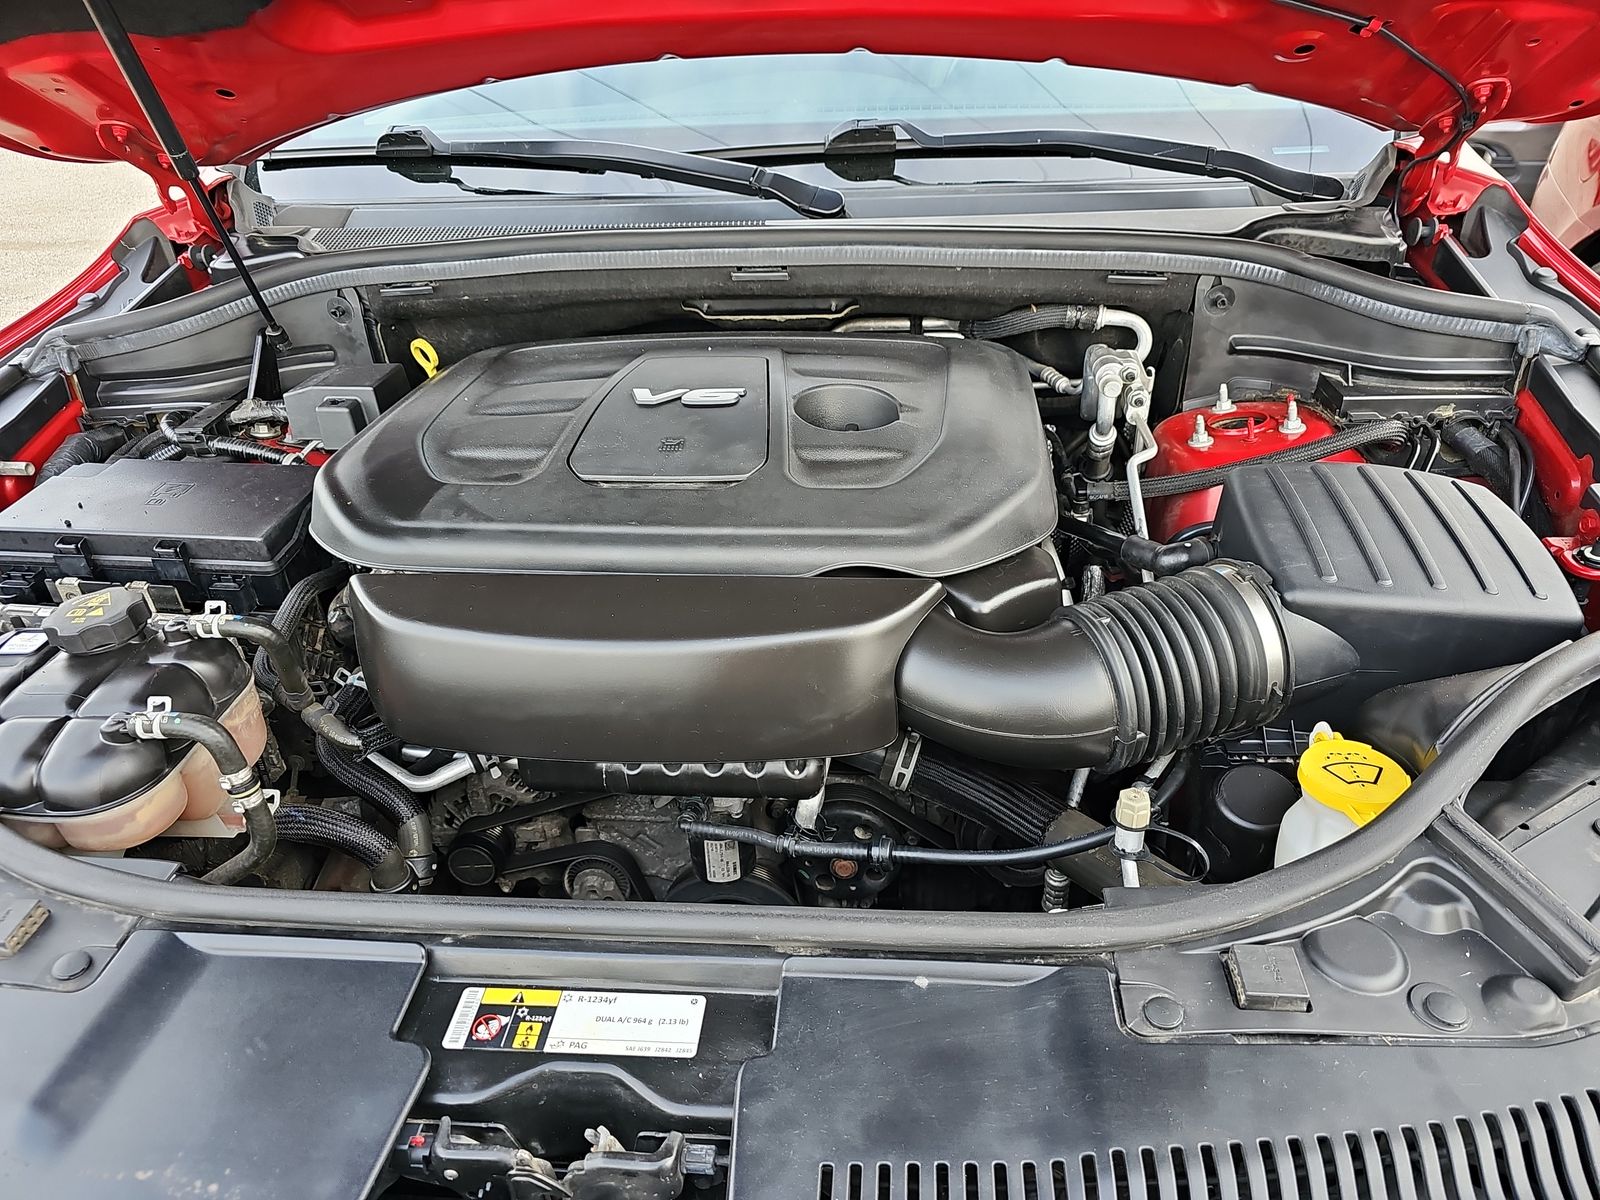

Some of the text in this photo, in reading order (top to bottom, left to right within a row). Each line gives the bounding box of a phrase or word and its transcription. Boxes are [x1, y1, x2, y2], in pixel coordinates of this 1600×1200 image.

[632, 387, 747, 408] V6
[577, 995, 618, 1005] R-1234yf
[595, 1015, 615, 1023] DUAL
[616, 1016, 632, 1024] A/C
[658, 1018, 677, 1026] (2.13
[678, 1018, 689, 1026] lb)
[568, 1041, 588, 1050] PAG
